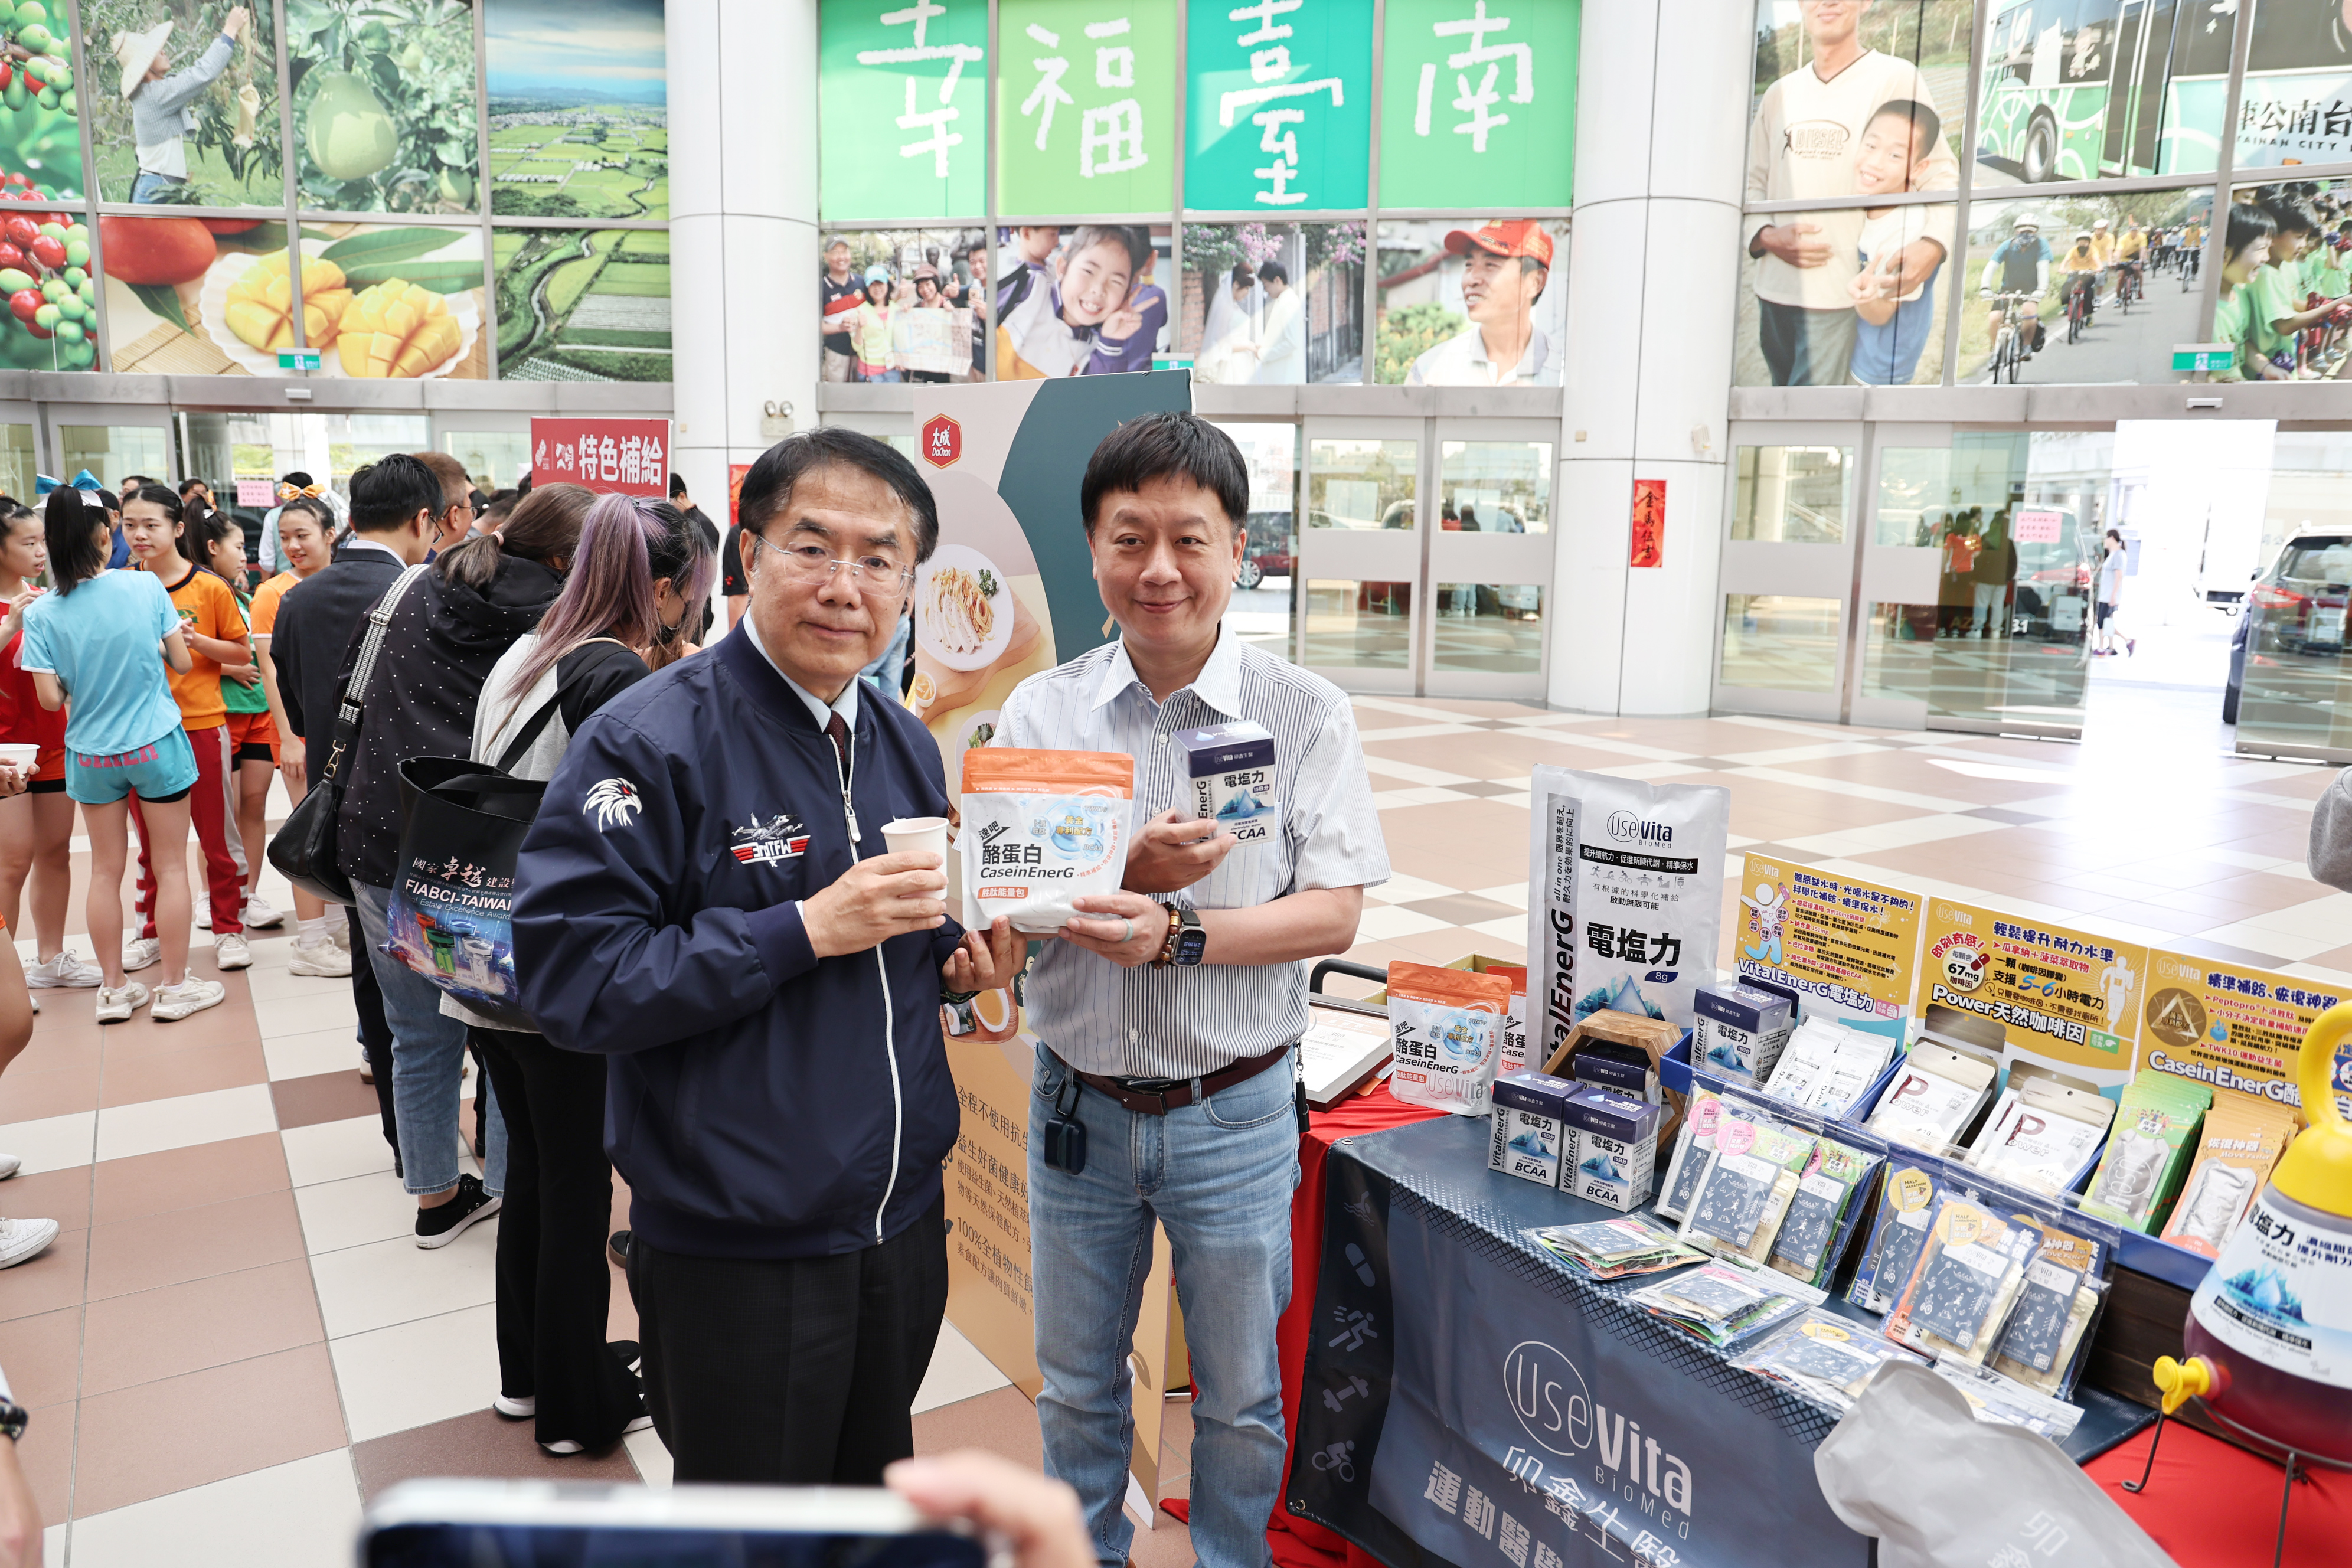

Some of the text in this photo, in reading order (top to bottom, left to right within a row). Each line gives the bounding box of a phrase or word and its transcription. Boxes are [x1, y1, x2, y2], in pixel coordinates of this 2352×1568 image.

[1796, 128, 1844, 151] DIESEL
[2299, 140, 2338, 151] CITY
[579, 434, 663, 486] 特色補給
[932, 447, 951, 457] DaChan
[1224, 770, 1264, 788] 電塩力
[1064, 816, 1083, 825] 黃金
[1611, 815, 1672, 842] UseVita
[978, 821, 1000, 841] 速吧
[1056, 826, 1092, 836] 專利配方
[1230, 827, 1266, 840] CAA
[1639, 839, 1671, 849] BioMed
[982, 844, 1042, 865] 酪蛋白
[1562, 808, 1574, 904] 耐久力を効果的に向上
[1584, 847, 1693, 871] 提升續航力 促進新陳代謝 精準保水
[981, 866, 1074, 878] CaseinEnerG
[1750, 860, 1779, 877] UseVita
[1555, 877, 1562, 887] in
[981, 888, 1025, 898] 胜肽能量包
[1592, 883, 1680, 902] 有根據的科學化補給
[420, 899, 442, 909] Estate
[445, 904, 485, 917] Excellence
[1796, 899, 1824, 913] 甜菜根濃縮
[1938, 904, 1972, 925] UseVita
[1812, 926, 1829, 936] 151mg
[1587, 922, 1681, 968] 電塩力
[1792, 941, 1815, 953] 巴拉金糖
[1994, 921, 2114, 962] 輕鬆提升耐力水準
[1952, 950, 1972, 961] 每顆含
[1655, 972, 1668, 984] 8g
[1948, 963, 1979, 982] 67mg
[2159, 960, 2201, 981] UseVita
[1738, 957, 1874, 1012] VitalEnerG電塩力
[1949, 976, 1973, 989] 咖啡因
[1932, 984, 2086, 1044] Power天然咖啡因
[2262, 1004, 2295, 1020] 卜派胜肽
[1447, 1033, 1474, 1043] 專利配方
[1454, 1025, 1468, 1034] 黃金
[1718, 1024, 1748, 1045] 電塩力
[1396, 1038, 1437, 1060] 酪蛋白
[1737, 1046, 1751, 1054] 15日分
[2209, 1043, 2283, 1069] TWK10 運動益生菌
[1395, 1054, 1459, 1074] CaseinEnerG
[1428, 1072, 1483, 1100] UseVita
[1520, 1112, 1553, 1131] 電塩力
[1492, 1107, 1505, 1168] VitalEnerG
[1592, 1135, 1625, 1155] 電塩力
[2209, 1138, 2260, 1151] 恢復神器
[1564, 1129, 1577, 1189] VitalEnerG
[1613, 1156, 1628, 1165] 15日分
[1515, 1162, 1547, 1178] BCAA
[1586, 1185, 1619, 1204] BCAA
[1516, 1353, 1692, 1517] UseVita
[1596, 1464, 1689, 1541] BioMed
